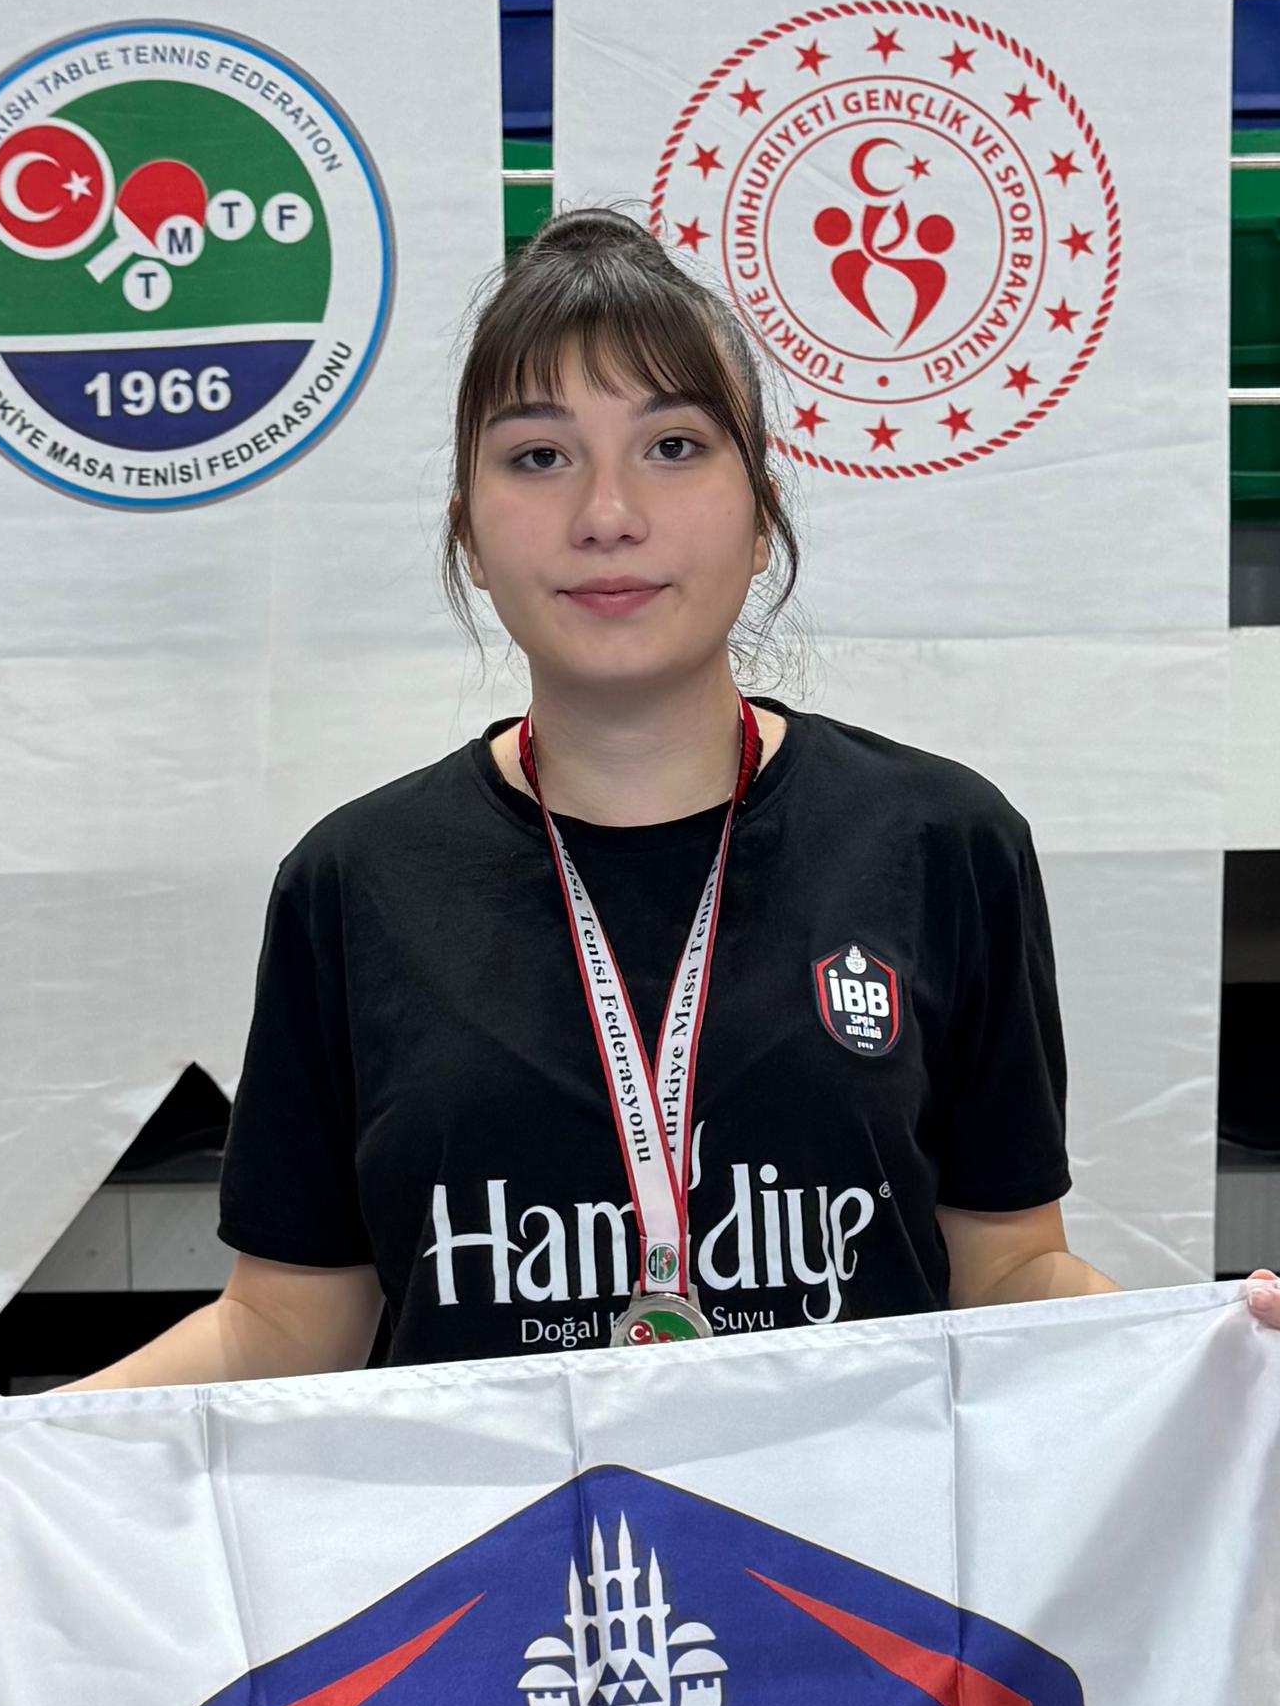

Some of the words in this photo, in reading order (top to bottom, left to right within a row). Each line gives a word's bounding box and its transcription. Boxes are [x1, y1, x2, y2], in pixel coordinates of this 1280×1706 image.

[35, 50, 113, 97] TABLE
[116, 44, 213, 70] TENNIS
[215, 56, 344, 173] FEDERATION
[841, 88, 971, 136] GENÇLİK
[969, 124, 1006, 166] VE
[732, 94, 837, 281] CUMHURİYETİ
[995, 164, 1035, 245] SPOR
[746, 286, 847, 386] TÜRKİYE
[921, 252, 1035, 384] BAKANLIĞI
[46, 440, 116, 484] MASA
[121, 456, 203, 488] TENİSİ
[207, 341, 354, 478] FEDERASYONU
[83, 365, 232, 418] 1966
[579, 909, 613, 986] Tenisi
[599, 992, 652, 1165] Federasyonu
[671, 966, 700, 1038] Masa
[828, 968, 890, 1018] İBB
[423, 1120, 876, 1325] Hamdiye
[521, 1311, 599, 1349] Doğal
